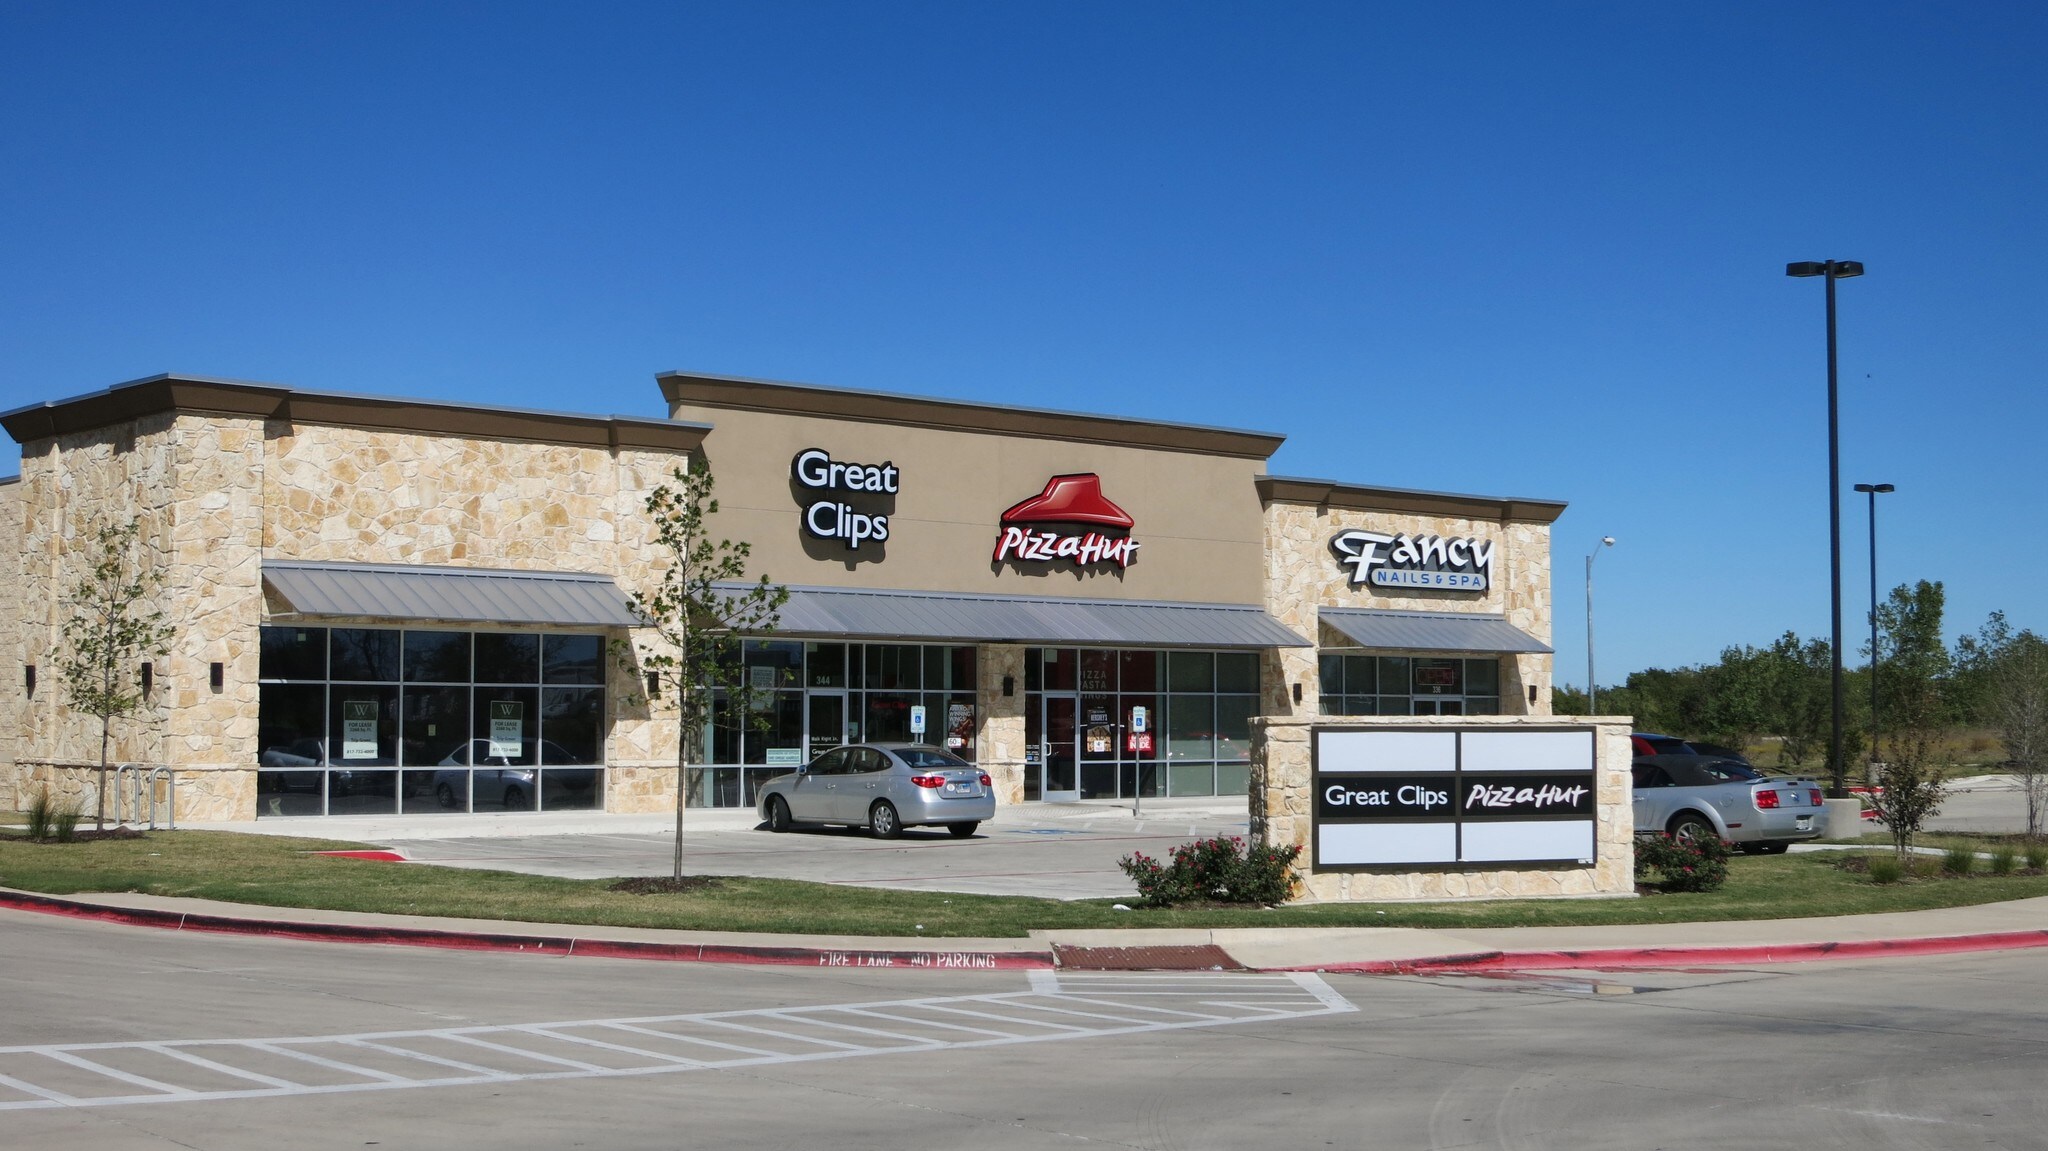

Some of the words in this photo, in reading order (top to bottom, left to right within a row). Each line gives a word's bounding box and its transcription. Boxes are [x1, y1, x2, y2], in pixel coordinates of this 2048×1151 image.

[797, 451, 897, 493] Great
[807, 501, 889, 548] Clips
[996, 527, 1079, 562] Pizza
[1079, 534, 1140, 567] Hut
[1334, 531, 1496, 590] Fancy
[1377, 571, 1430, 584] NAILS
[1435, 575, 1443, 584] &
[1448, 574, 1481, 587] SPA
[816, 675, 830, 685] 344
[1432, 685, 1441, 694] 336
[354, 704, 369, 716] W
[501, 704, 514, 716] W
[1325, 785, 1390, 806] Great
[1397, 785, 1448, 810] Clips
[1465, 784, 1534, 810] Pizza
[1531, 784, 1589, 809] Hut
[819, 951, 851, 966] FIRE
[857, 952, 894, 967] LANE
[910, 952, 930, 967] NO
[936, 952, 996, 968] PARKING
